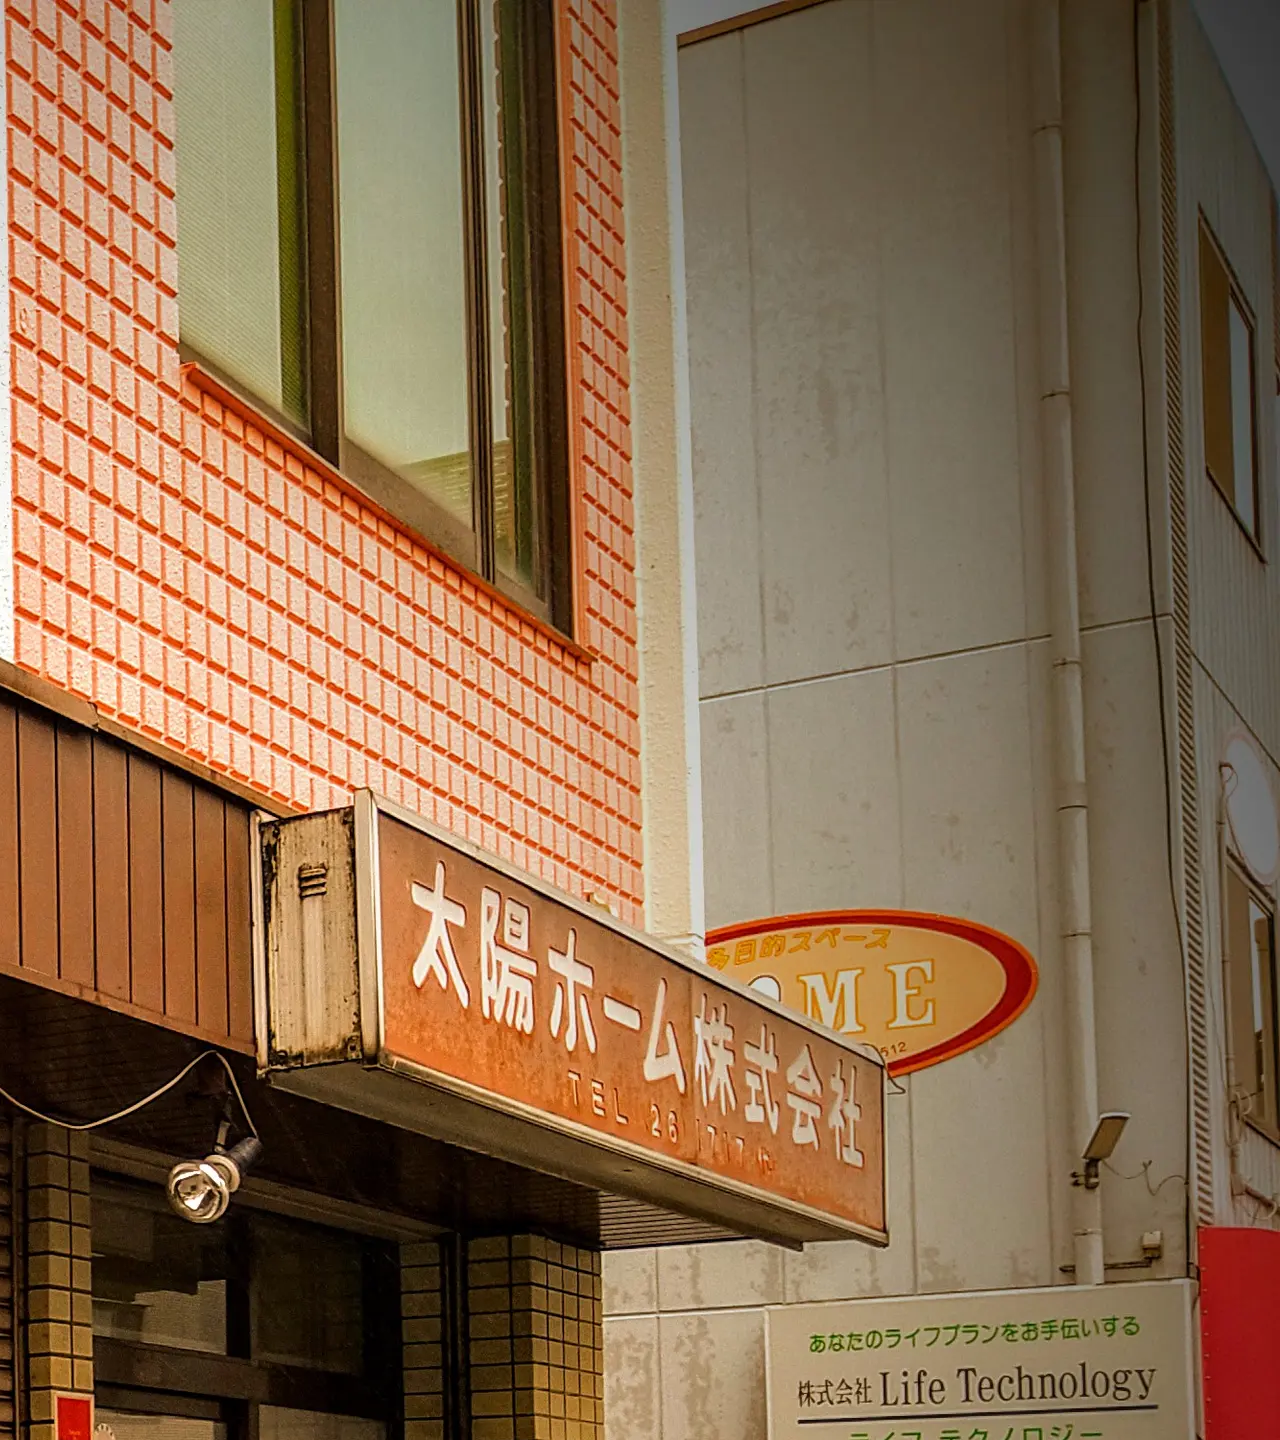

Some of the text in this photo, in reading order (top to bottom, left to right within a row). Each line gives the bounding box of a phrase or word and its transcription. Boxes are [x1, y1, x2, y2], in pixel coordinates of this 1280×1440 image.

[707, 927, 891, 971] 多目的スペース
[411, 860, 864, 1168] 太陽ホーム株式会社
[567, 1069, 628, 1125] TEL
[809, 1315, 1141, 1353] あなたのライフプランをお手伝いする
[798, 1360, 1156, 1408] 株式会社 Life Technology
